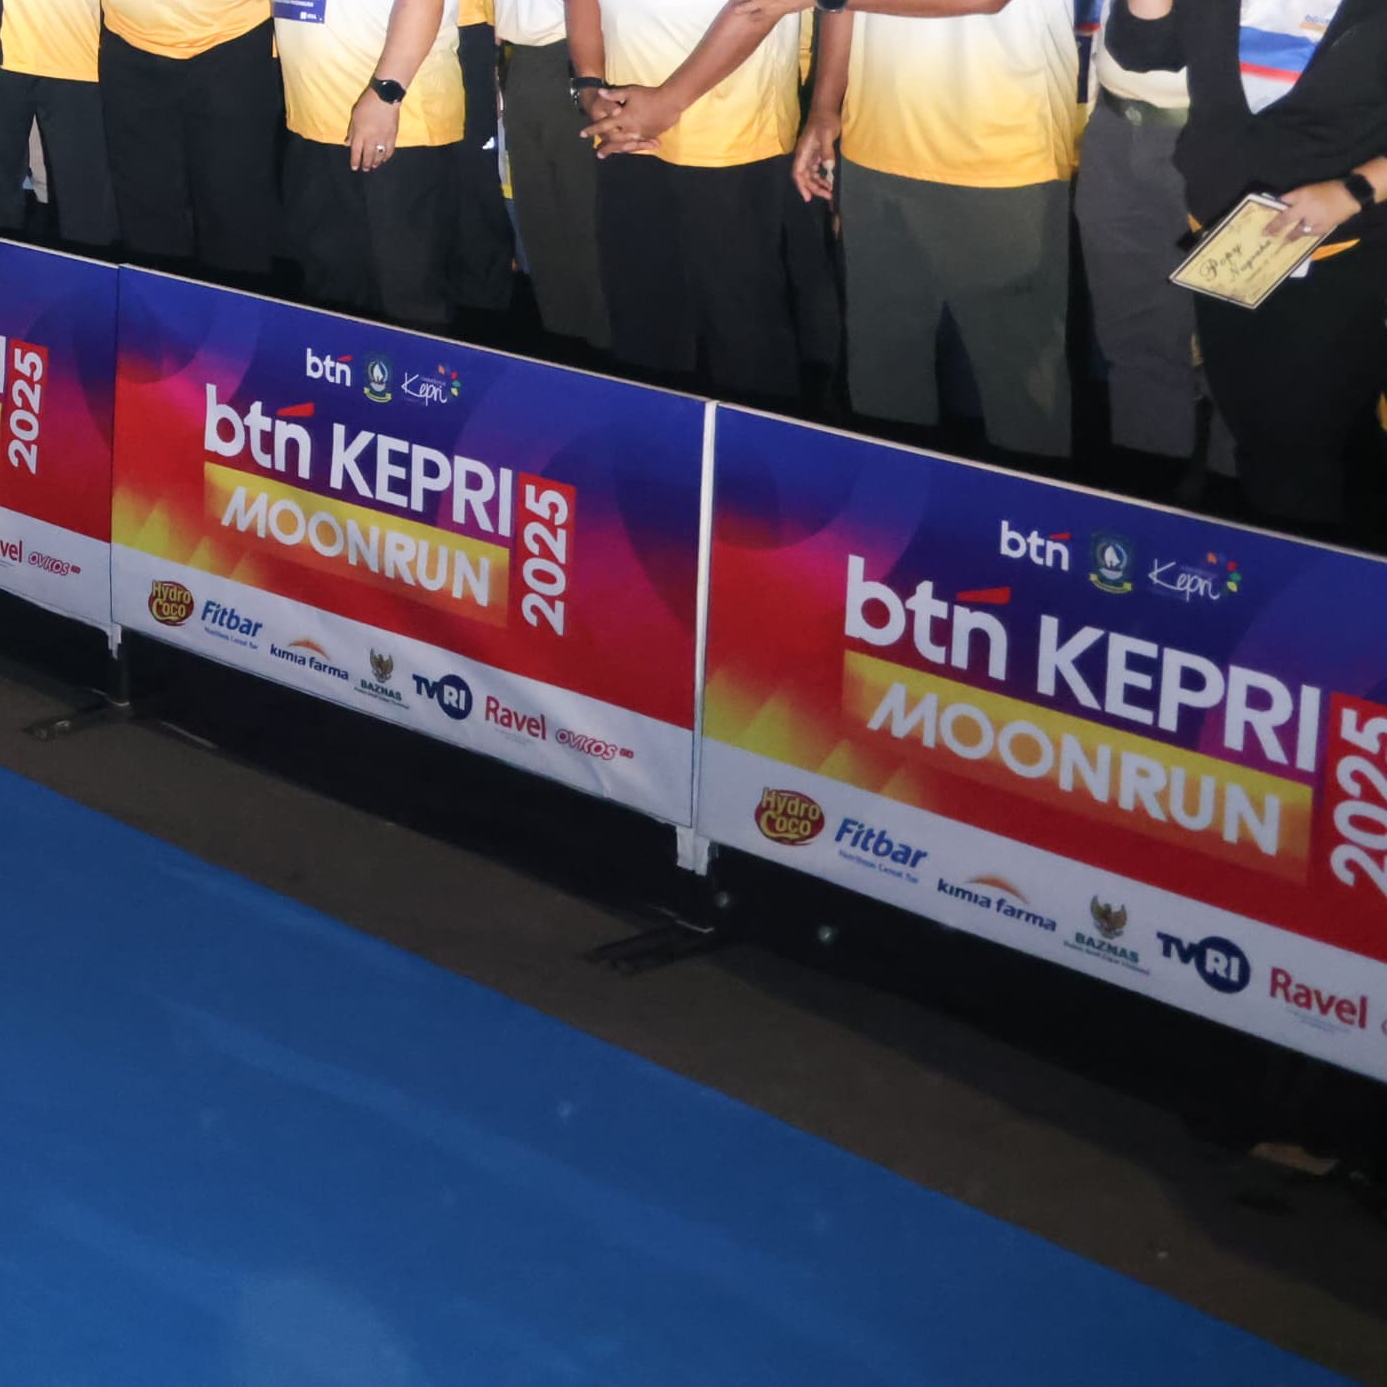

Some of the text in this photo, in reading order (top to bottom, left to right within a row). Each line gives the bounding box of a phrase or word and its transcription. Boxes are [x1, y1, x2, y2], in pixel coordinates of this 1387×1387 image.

[306, 347, 448, 407] btn Kepri
[8, 347, 44, 475] 2025
[204, 383, 513, 537] btn KEPRI
[220, 485, 490, 607] MOONRUN
[521, 484, 570, 636] 2025
[1000, 520, 1220, 602] btn Kepri
[152, 579, 191, 604] Hydro
[152, 600, 186, 621] Coco
[201, 600, 263, 637] Fitbar
[270, 643, 349, 681] kimia farma
[844, 554, 1321, 772] btn KEPRI
[360, 679, 402, 702] BAZNAS
[485, 696, 547, 740] Ravel
[867, 682, 1281, 856] MOONRUN
[761, 787, 821, 821] Hydro
[1330, 707, 1387, 887] 2025
[761, 815, 811, 839] Coco
[834, 817, 929, 869] Fitbar
[936, 878, 1057, 932] kimia farma
[1074, 932, 1140, 964] BAZNAS
[1270, 966, 1369, 1030] Ravel
